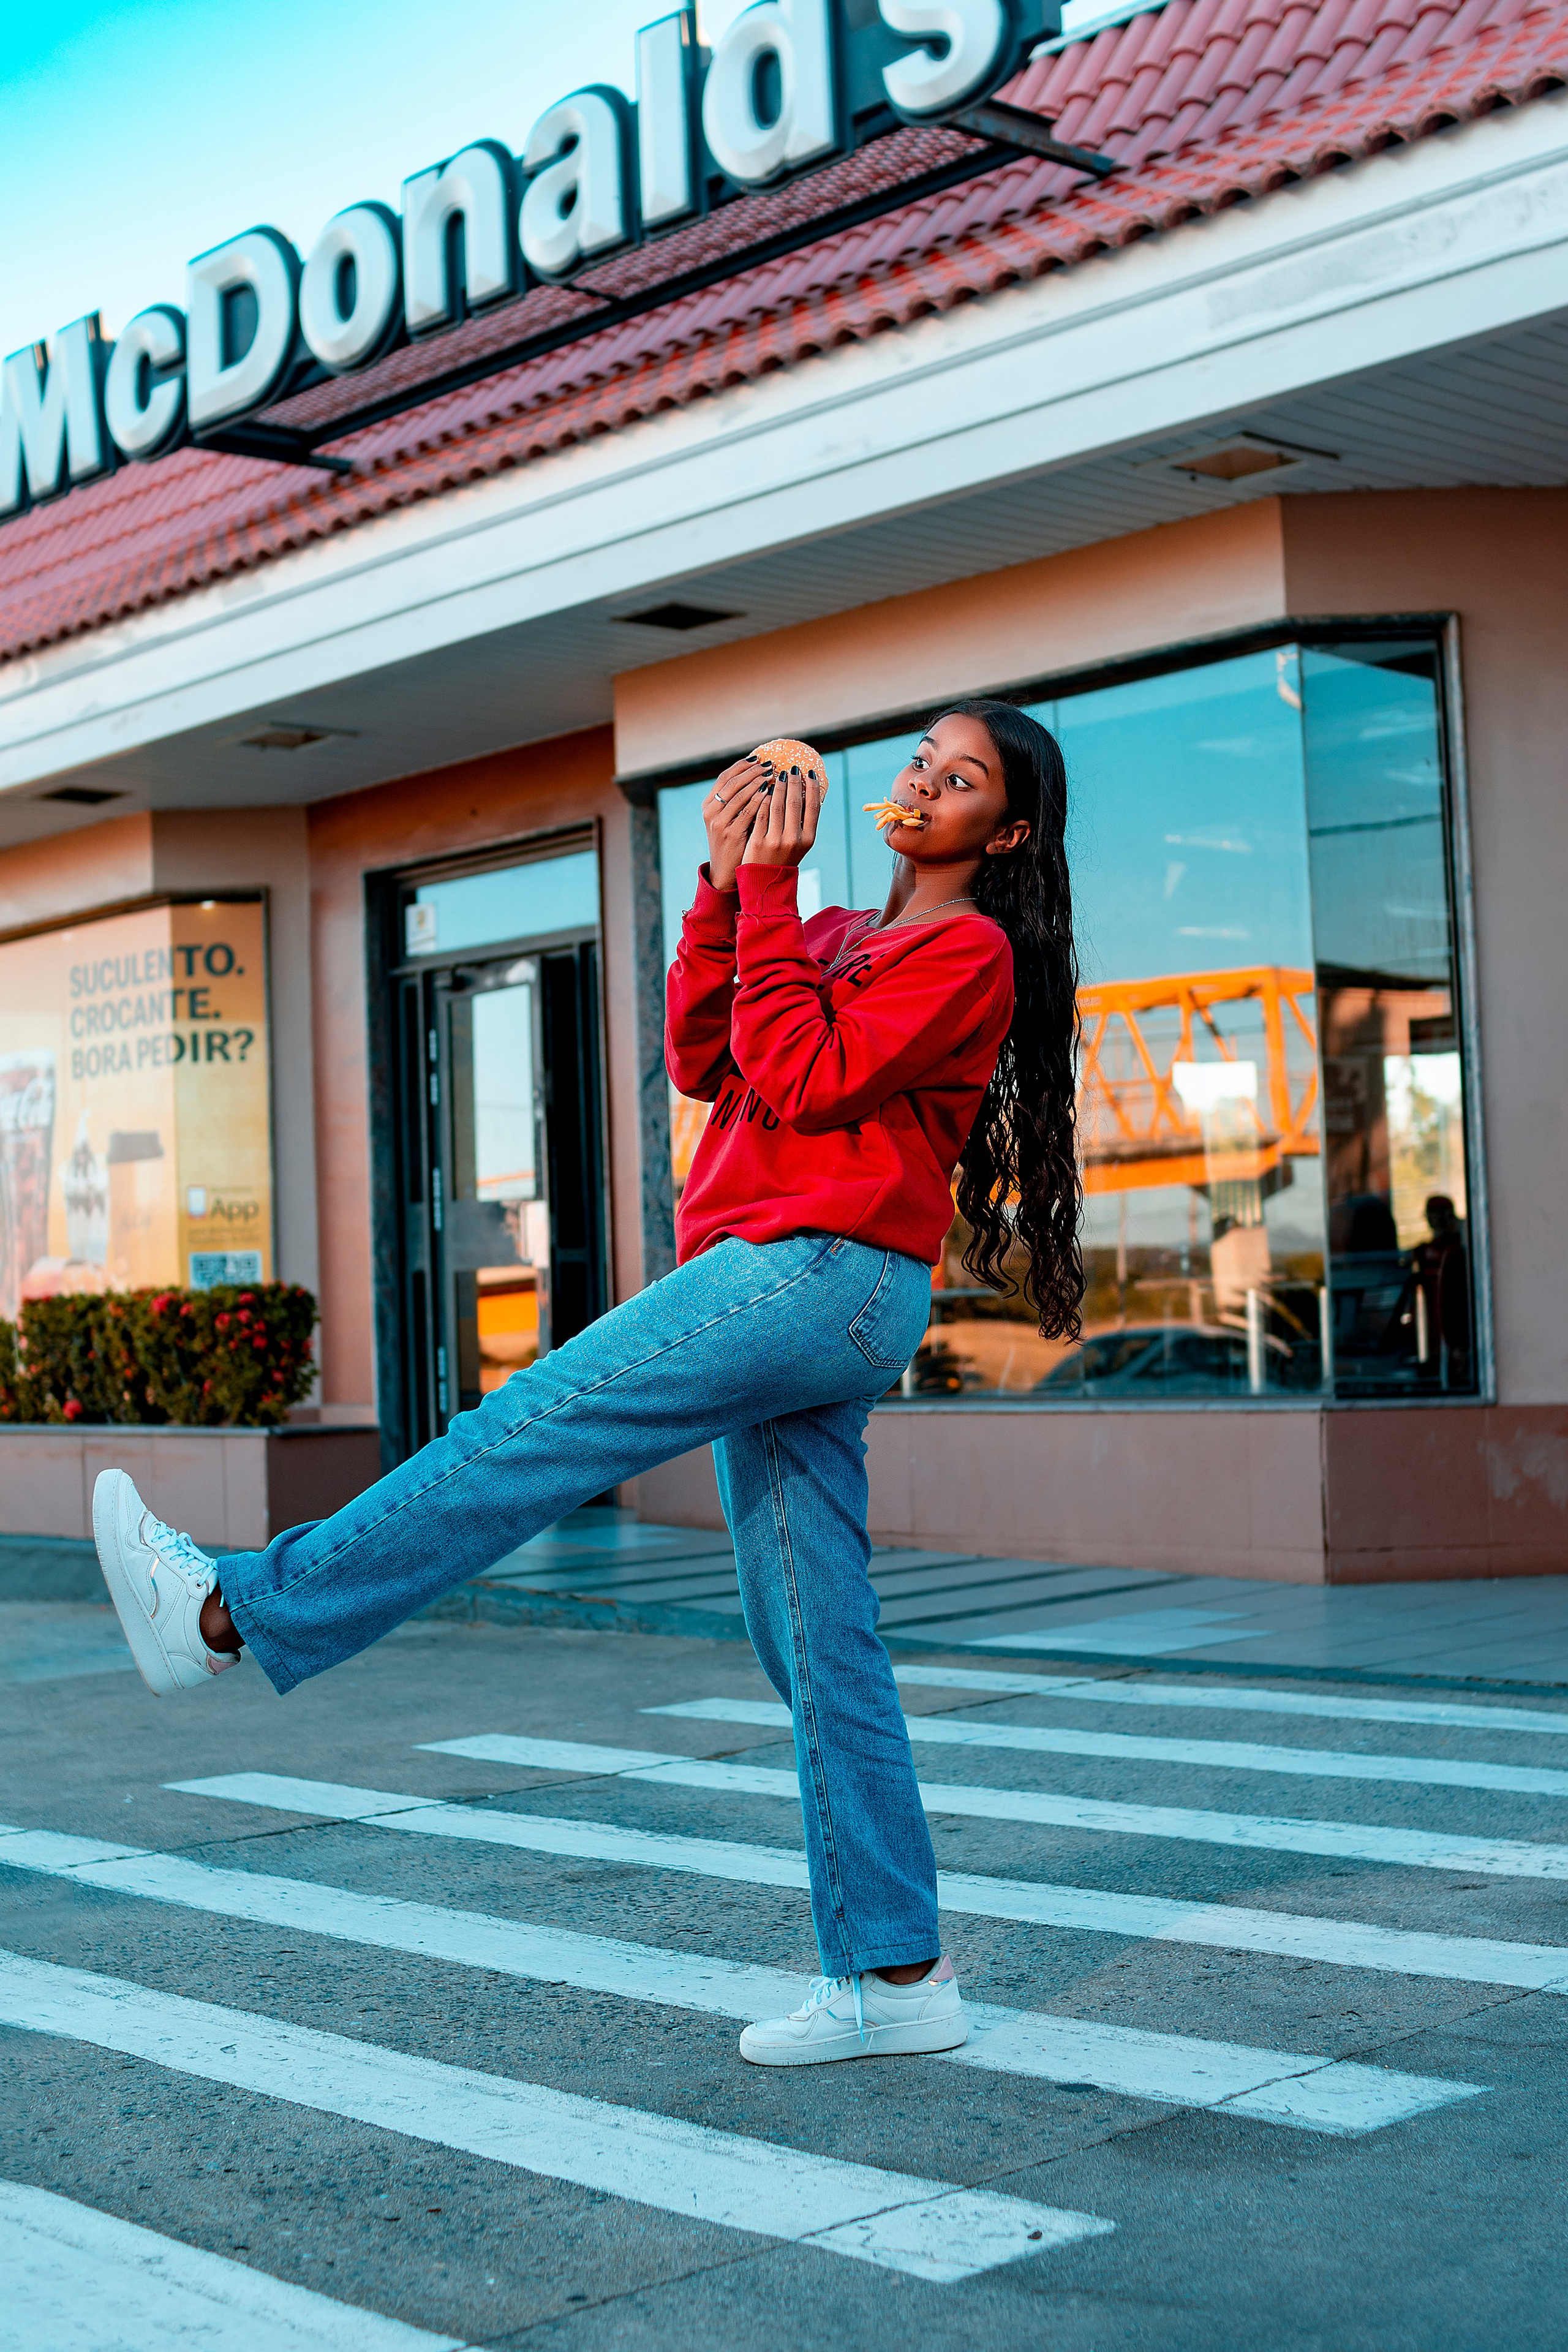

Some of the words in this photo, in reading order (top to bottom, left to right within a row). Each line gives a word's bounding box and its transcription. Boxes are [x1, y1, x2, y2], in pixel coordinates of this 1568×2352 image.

[69, 943, 244, 998] SUCULENTO.
[70, 987, 221, 1039] CROCANTE.
[72, 1040, 133, 1079] BORA
[136, 1028, 255, 1071] PEDIR?
[210, 1197, 259, 1223] App
